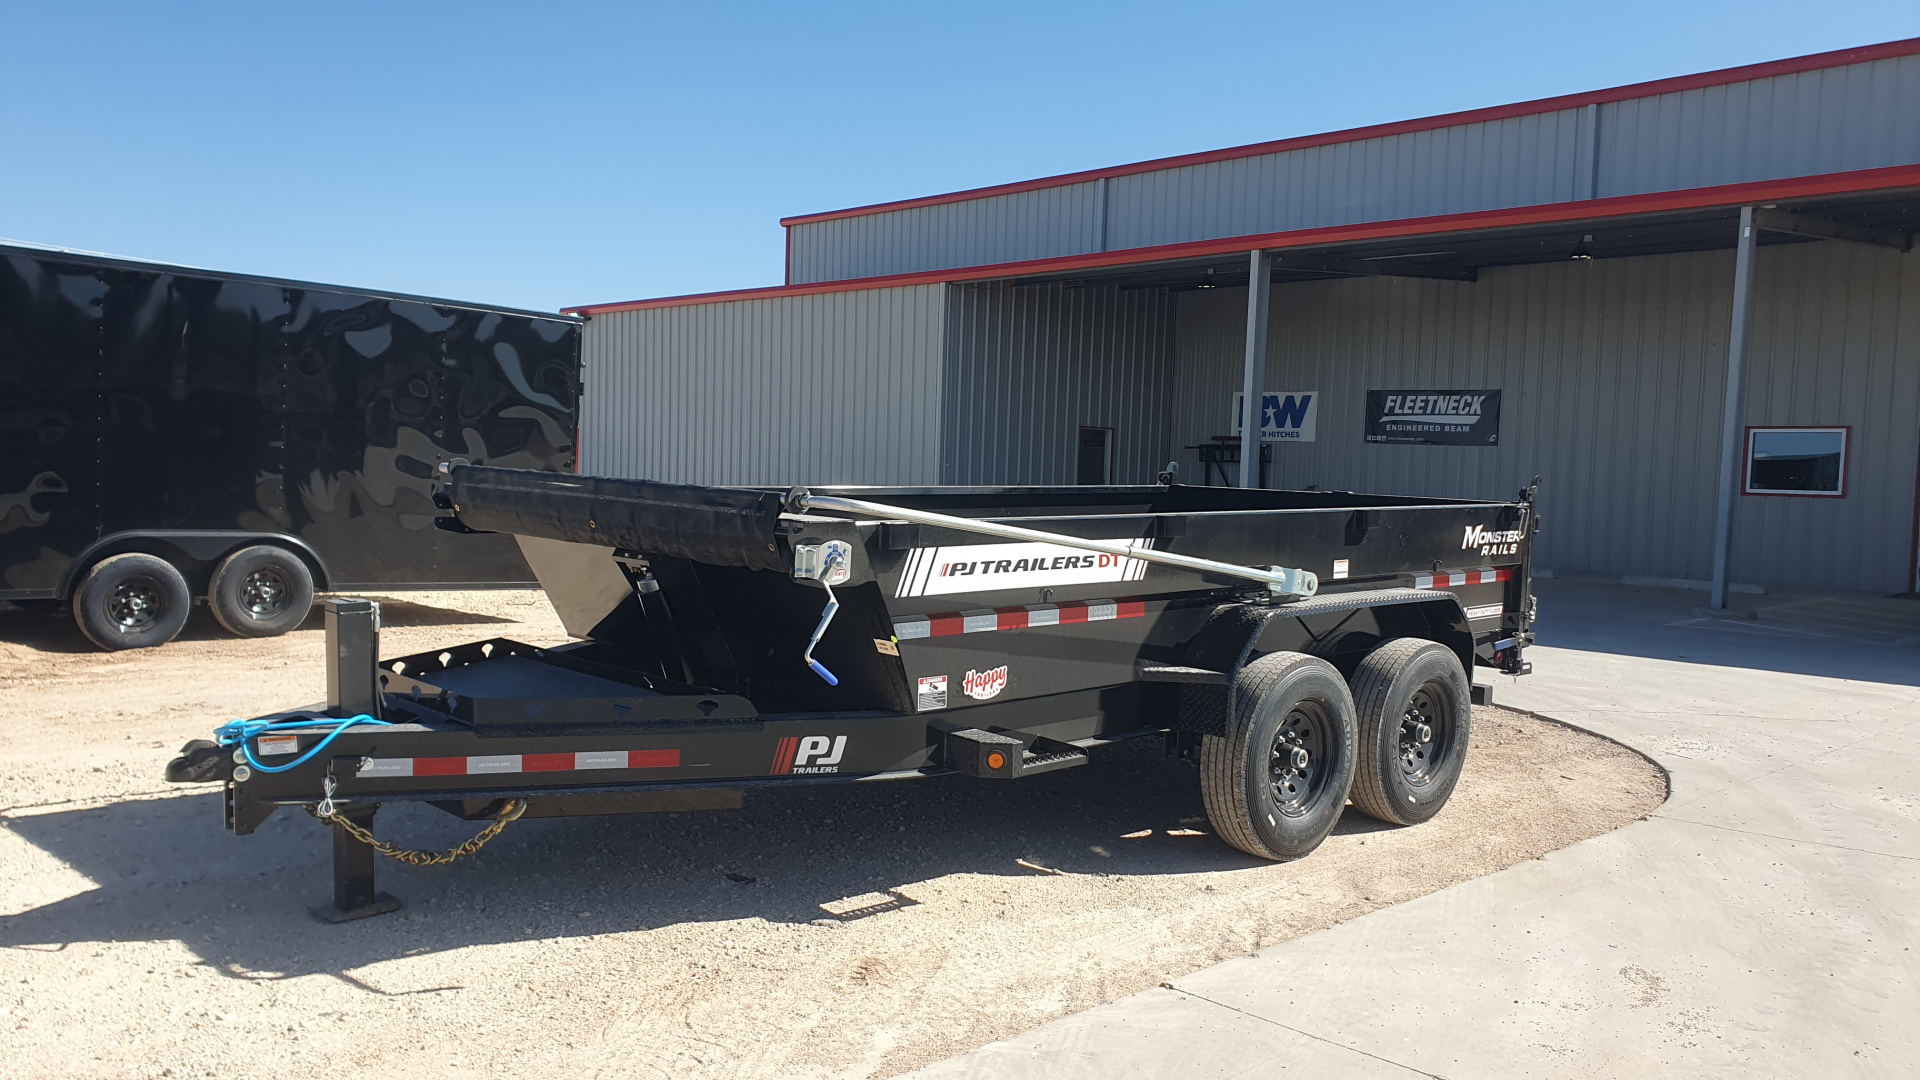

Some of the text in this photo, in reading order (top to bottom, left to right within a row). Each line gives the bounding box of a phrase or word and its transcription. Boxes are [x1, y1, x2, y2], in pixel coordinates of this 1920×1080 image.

[1383, 395, 1486, 415] FLEETNECK
[1386, 424, 1470, 433] ENGINEERED BEAM
[1480, 543, 1518, 556] RAILS
[949, 561, 978, 577] PJ
[979, 555, 1096, 575] TRAILERS
[964, 667, 1007, 694] Happy
[795, 735, 848, 766] PJ
[793, 766, 839, 775] TRAILERS
